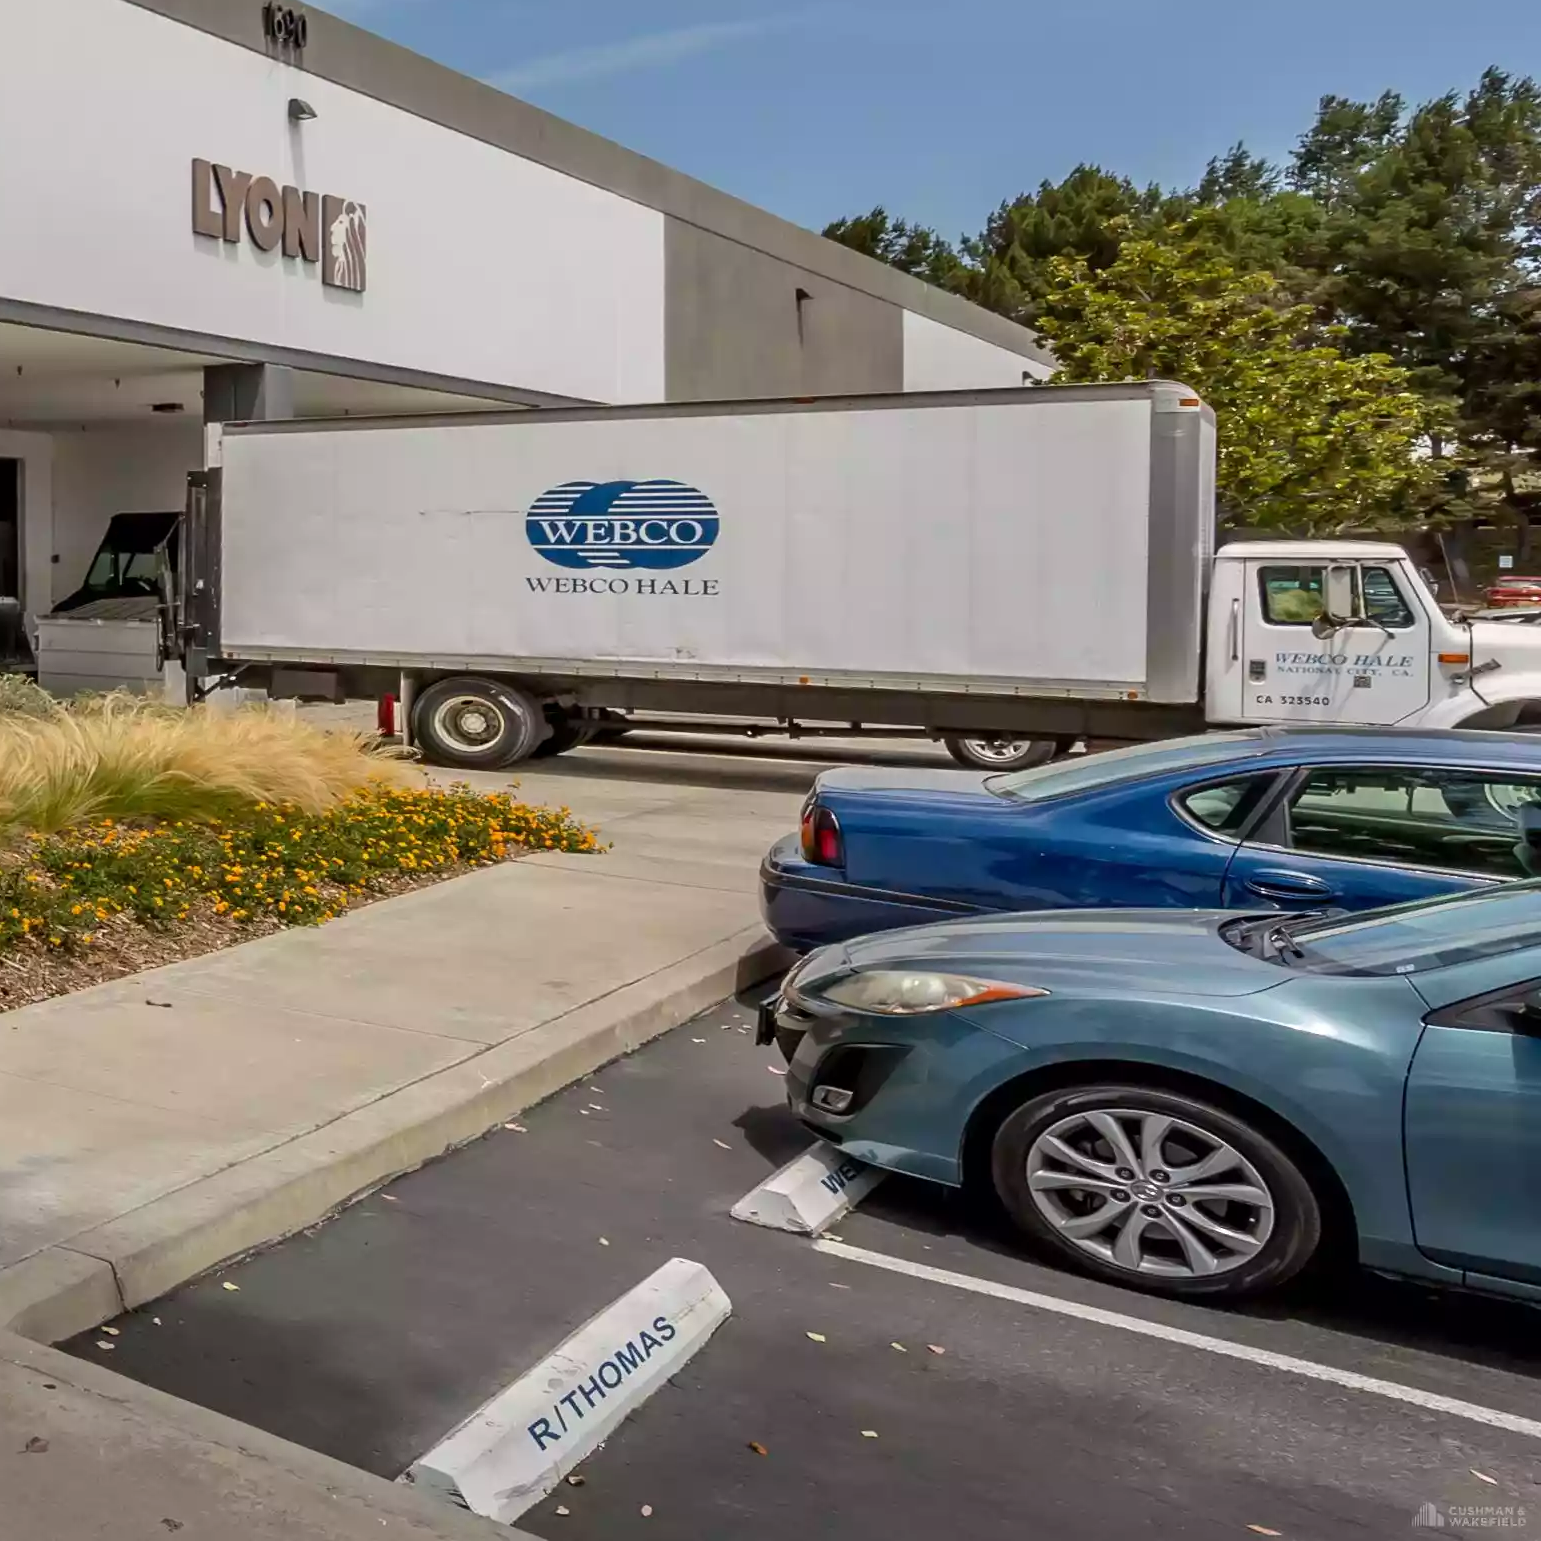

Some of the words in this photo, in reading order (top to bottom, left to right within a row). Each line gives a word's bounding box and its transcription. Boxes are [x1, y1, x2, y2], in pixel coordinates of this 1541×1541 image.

[191, 157, 319, 263] LYON
[538, 519, 704, 544] WEBCO
[525, 577, 629, 594] WEBCO
[635, 578, 721, 596] HALE
[1275, 652, 1348, 666] WEBCO
[1353, 654, 1415, 668] HALE
[1277, 665, 1341, 675] NATIONAL
[1256, 695, 1273, 704] CA
[1280, 695, 1330, 706] 323540
[527, 1315, 677, 1451] R/THOMAS
